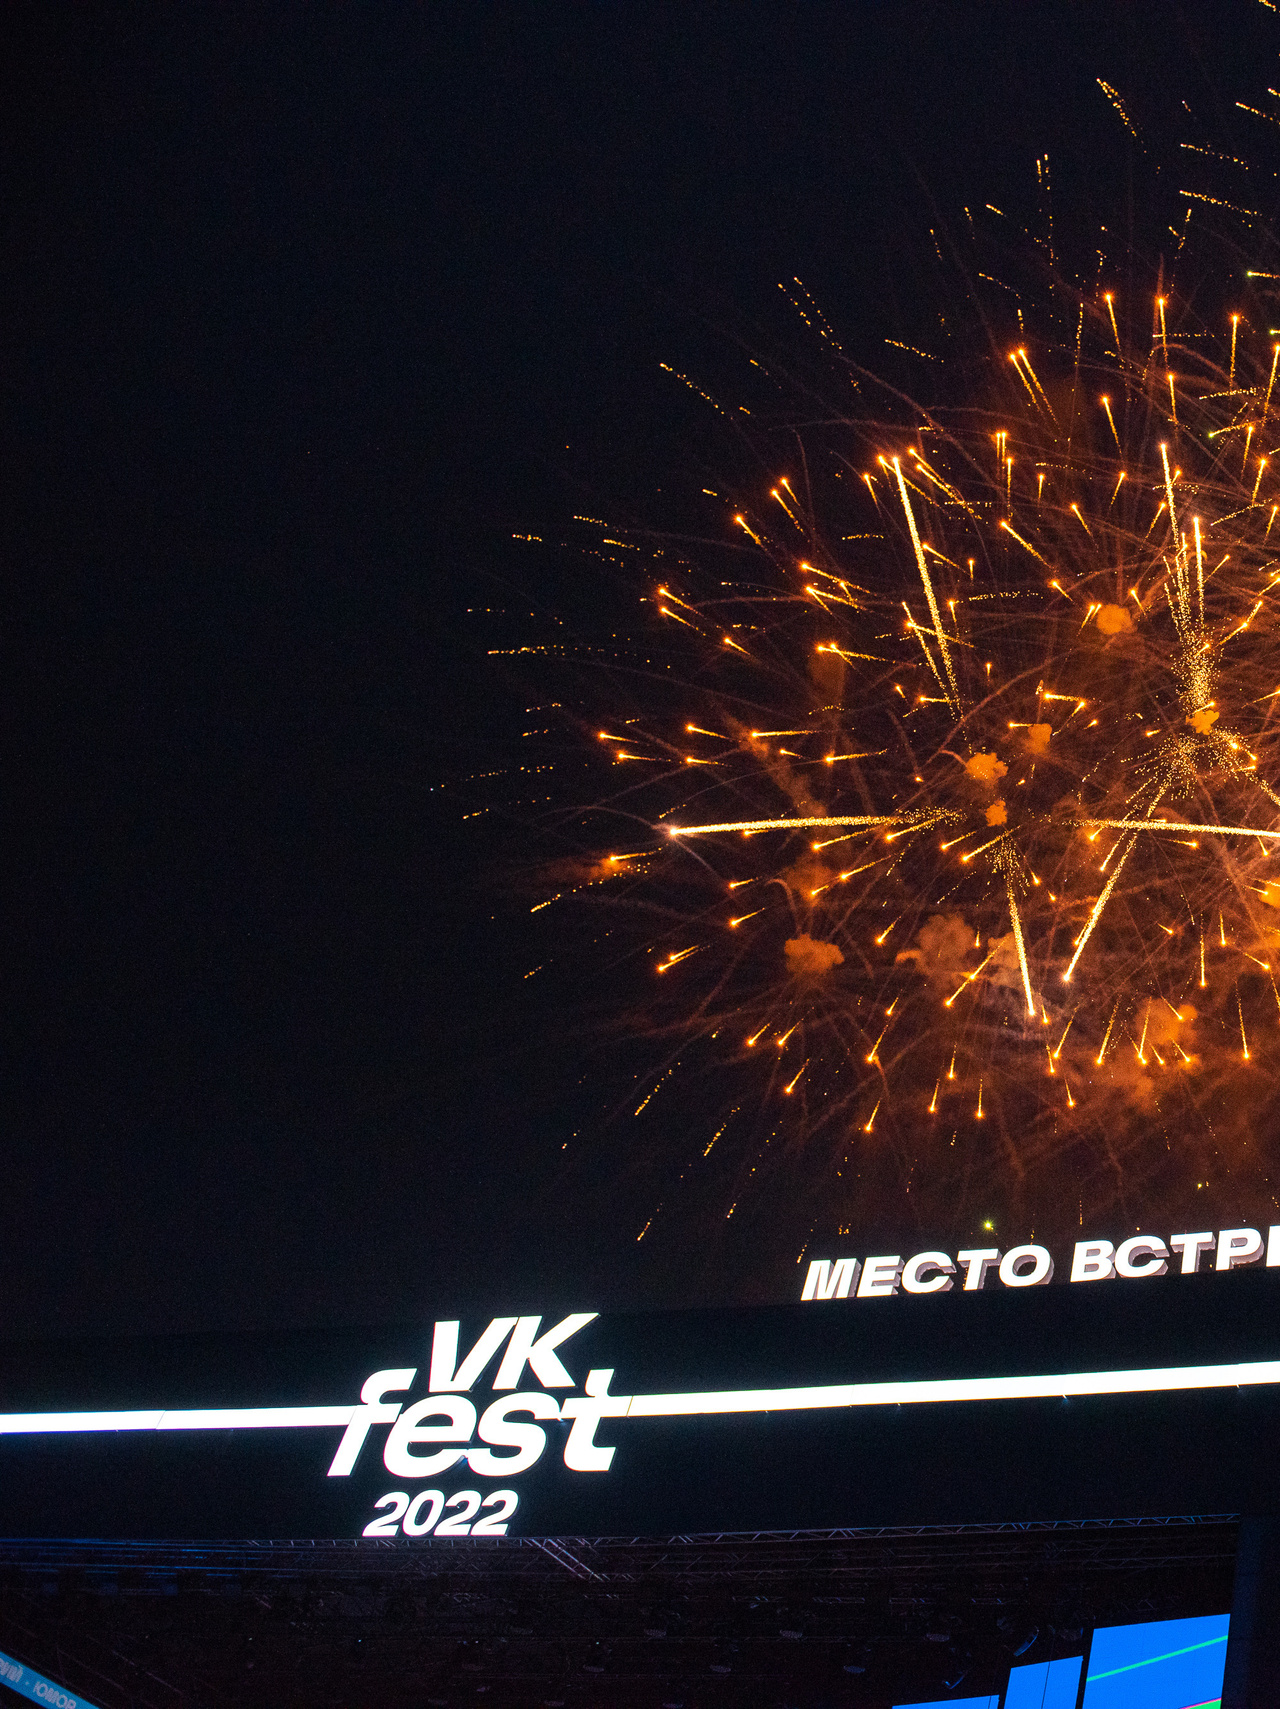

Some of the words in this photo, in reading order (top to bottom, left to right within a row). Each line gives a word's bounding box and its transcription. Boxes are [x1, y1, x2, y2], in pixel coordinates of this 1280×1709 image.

[801, 1244, 1054, 1301] МЕСТО
[428, 1312, 600, 1392] VK
[327, 1368, 616, 1478] fest
[362, 1489, 519, 1537] 2022
